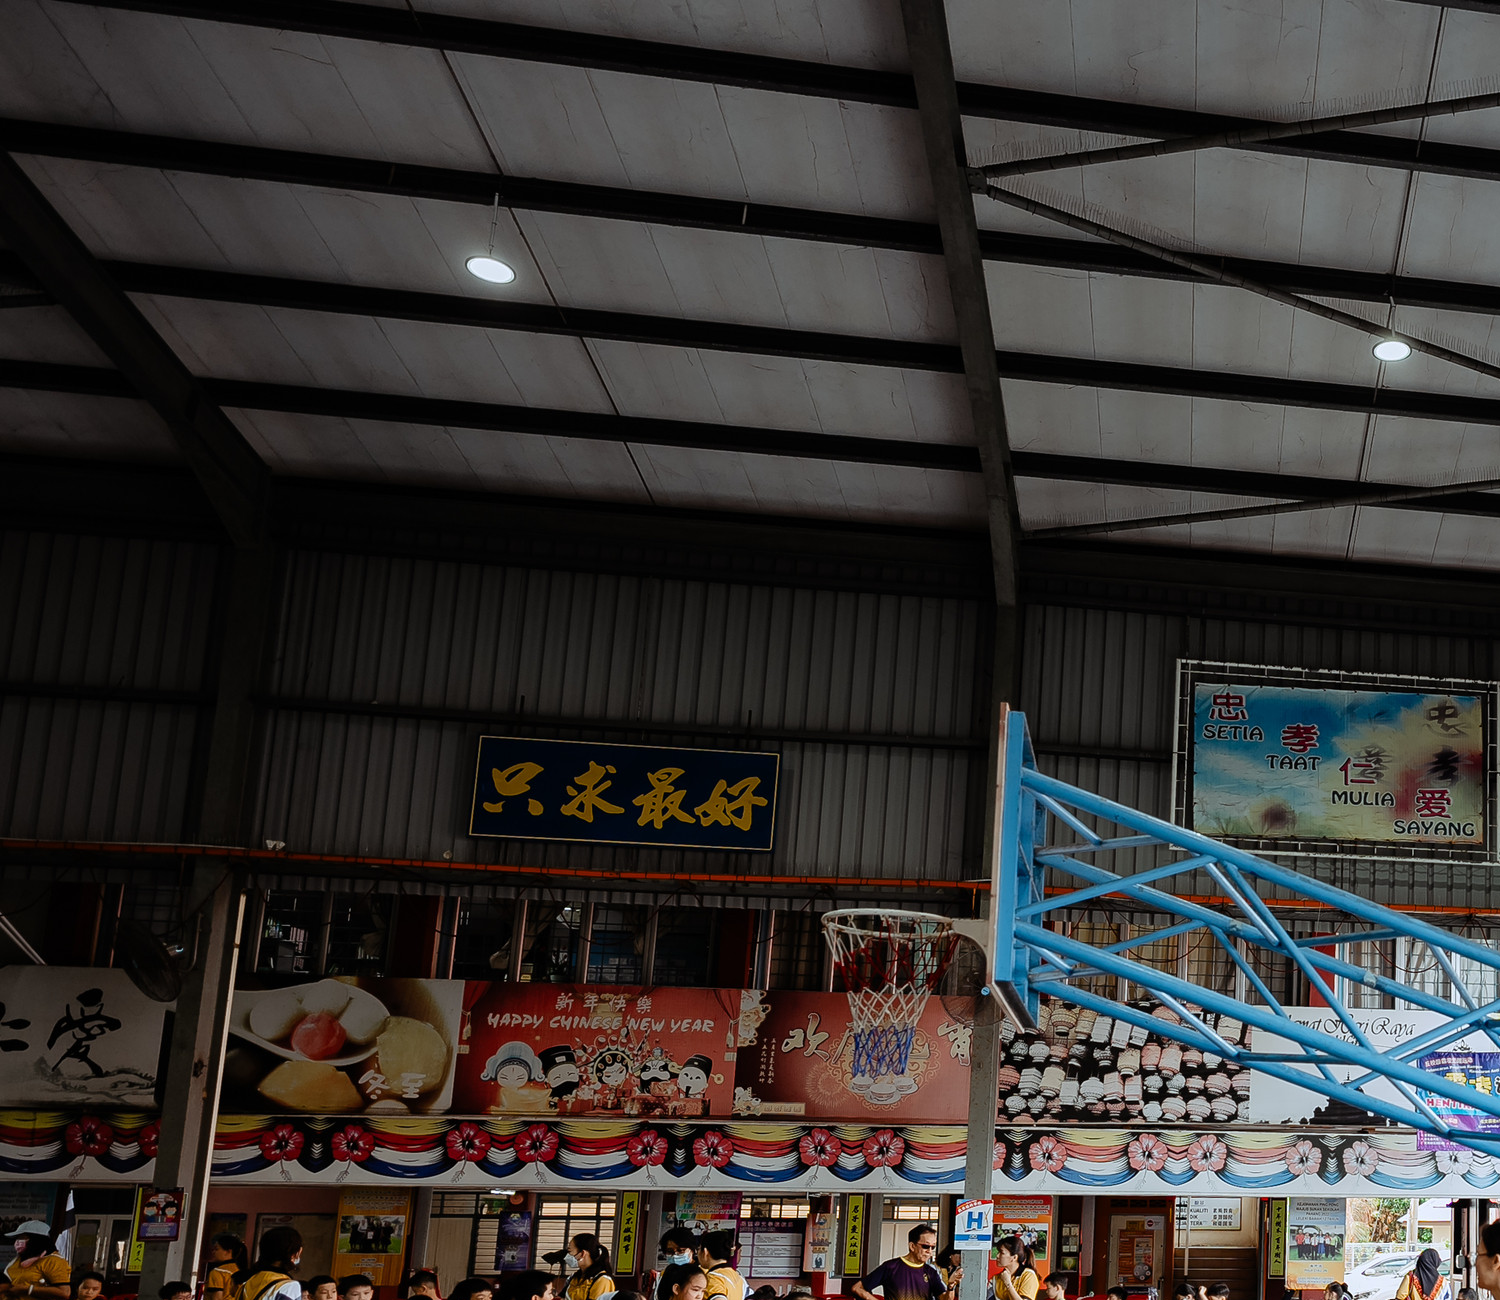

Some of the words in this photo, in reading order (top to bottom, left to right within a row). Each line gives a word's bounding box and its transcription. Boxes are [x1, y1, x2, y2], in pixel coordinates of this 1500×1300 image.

[1208, 691, 1248, 721] 忠
[1203, 724, 1264, 741] SETIA
[1281, 723, 1320, 753] 孝
[1265, 755, 1321, 771] TAAT
[1339, 757, 1376, 786] 仁
[482, 760, 768, 831] 只求最好
[1331, 790, 1396, 807] MULIA
[1415, 788, 1452, 819] 爱
[1393, 820, 1475, 837] SAYANG
[554, 992, 652, 1014] 新年快樂
[487, 1012, 544, 1029] HAPPY
[549, 1014, 622, 1031] CHINESE
[626, 1017, 666, 1032] NEW
[669, 1018, 715, 1033] YEAR
[1379, 1017, 1416, 1038] Raya
[358, 1063, 426, 1100] 冬至
